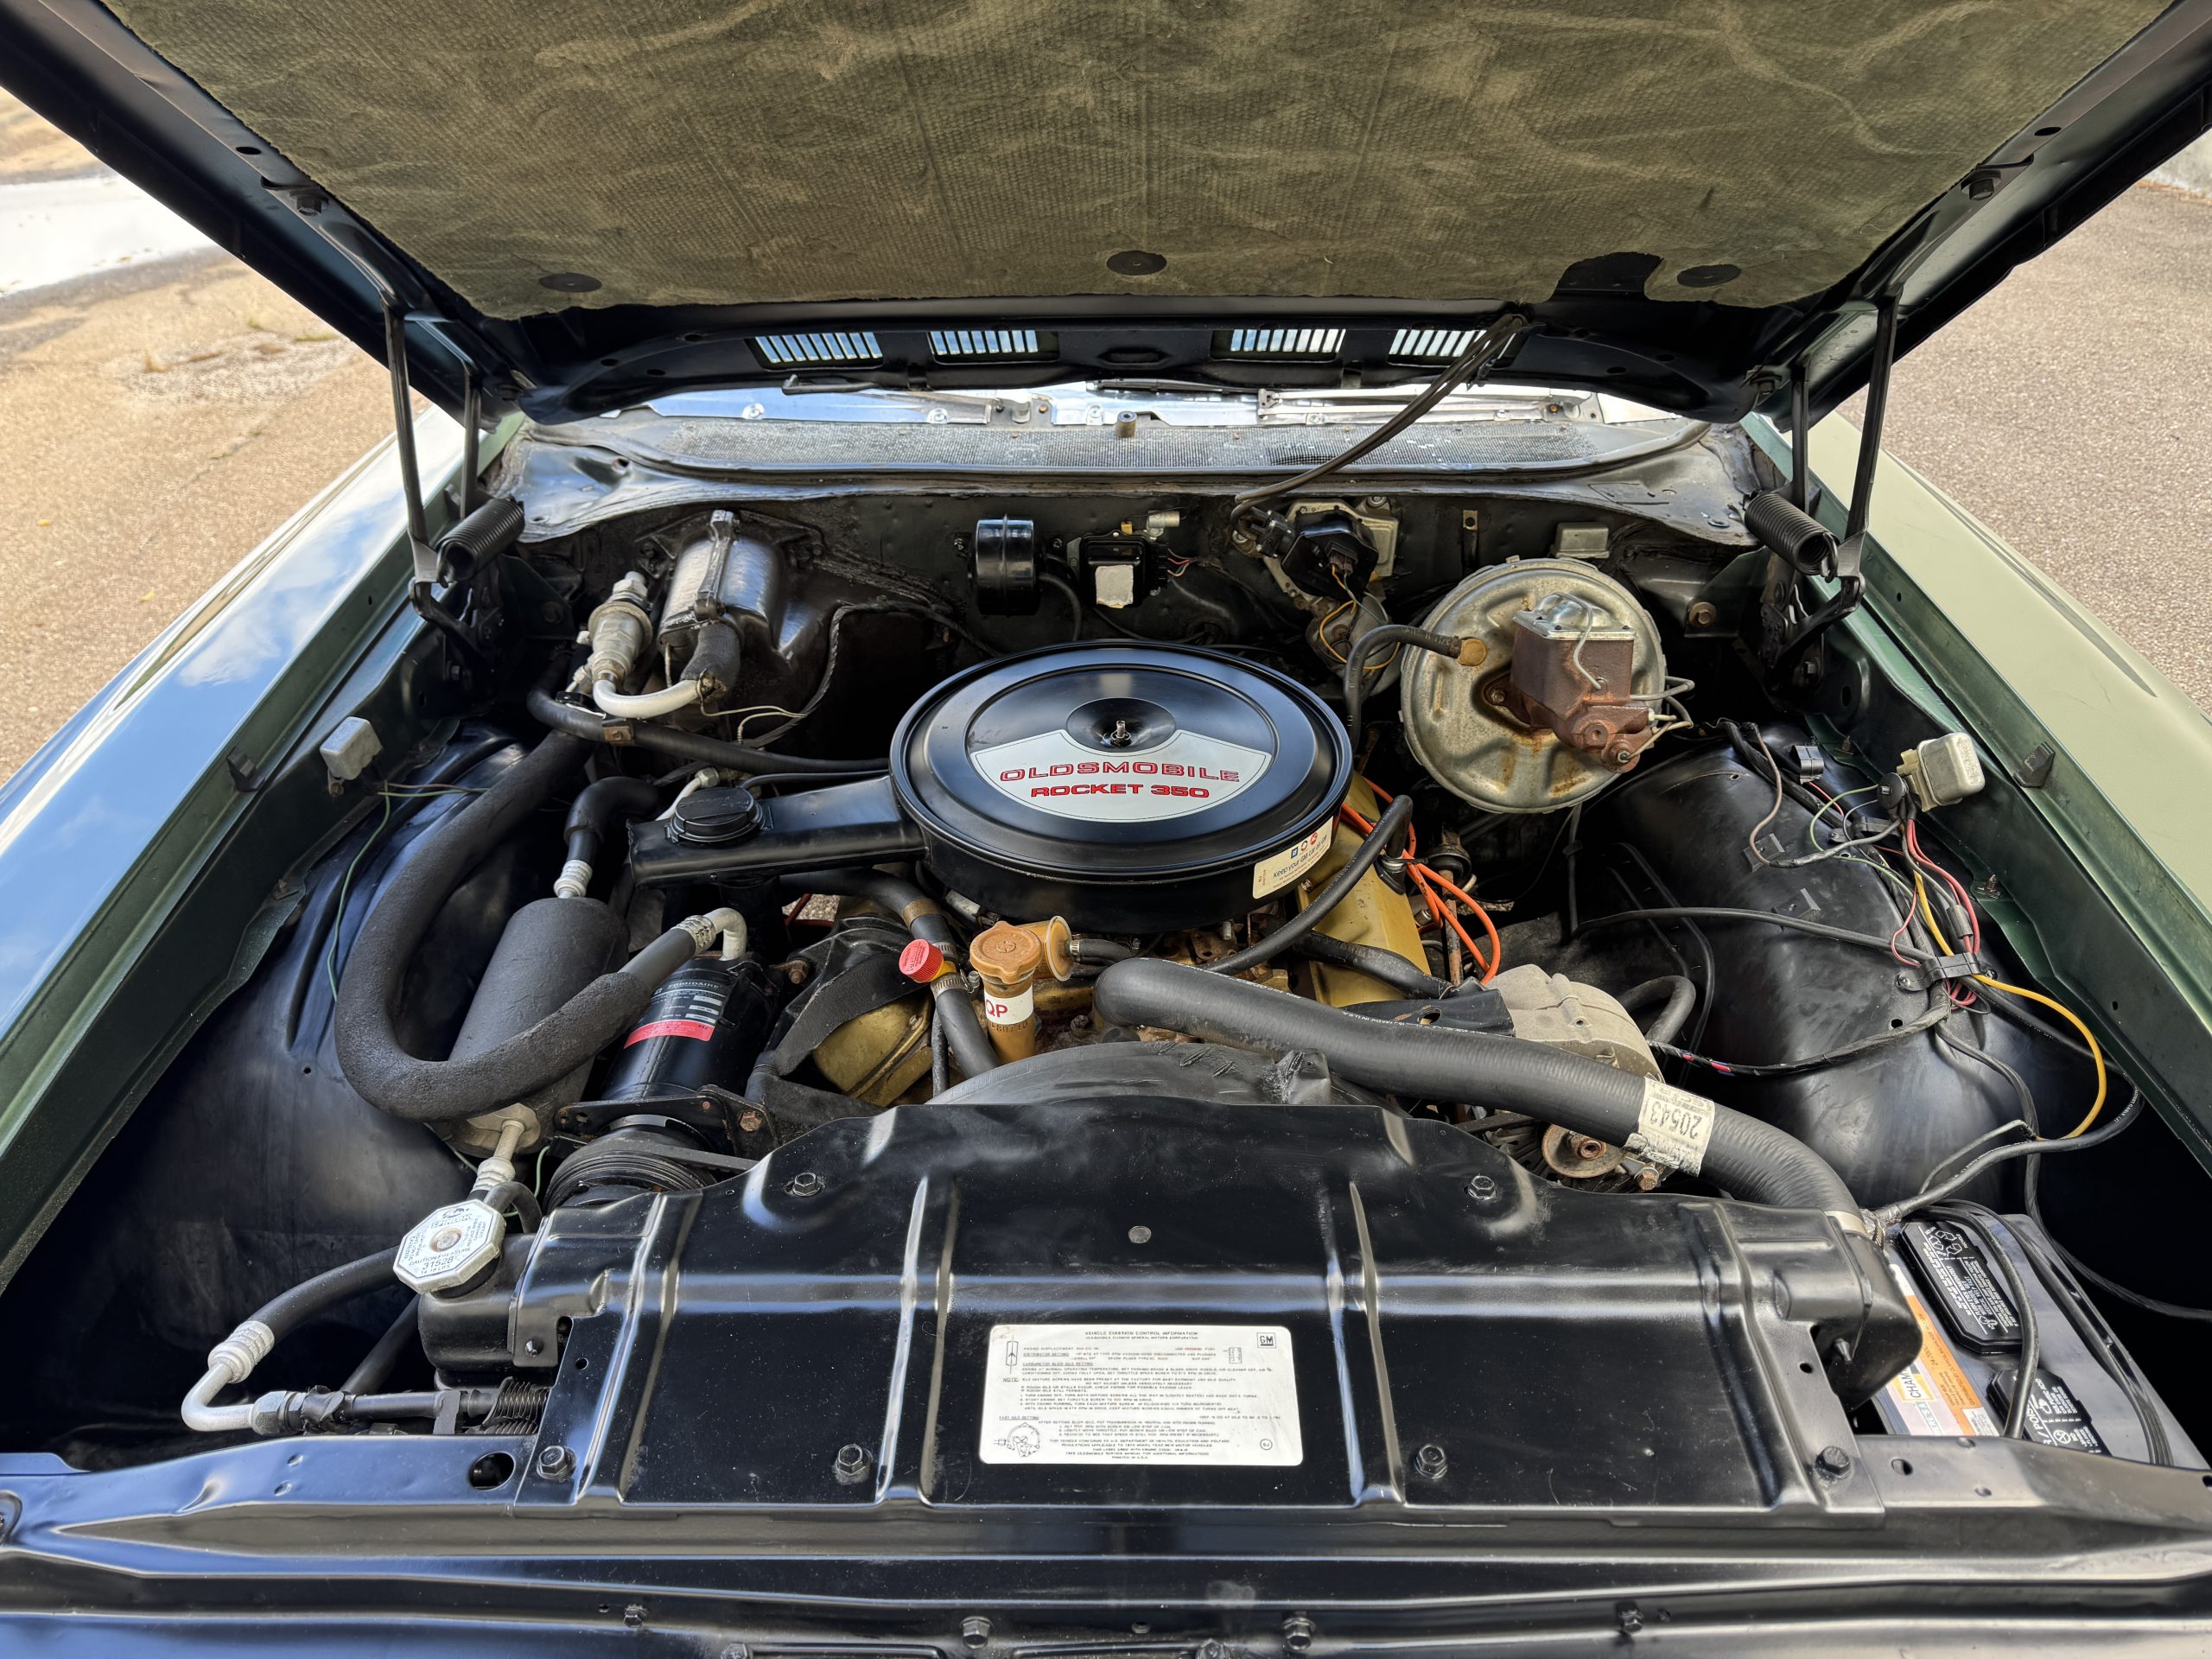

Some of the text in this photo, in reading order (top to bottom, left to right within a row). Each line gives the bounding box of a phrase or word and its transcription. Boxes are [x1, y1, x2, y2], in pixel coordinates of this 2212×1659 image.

[1000, 761, 1240, 783] OLDSMOBILE
[1031, 784, 1210, 798] ROCKET 350
[1273, 866, 1288, 878] Keep
[1288, 860, 1300, 871] your
[986, 999, 1008, 1018] QP
[1650, 1101, 1703, 1140] 20543
[409, 1256, 436, 1266] CAUTION
[423, 1256, 454, 1270] 31528
[1260, 1335, 1274, 1346] GM
